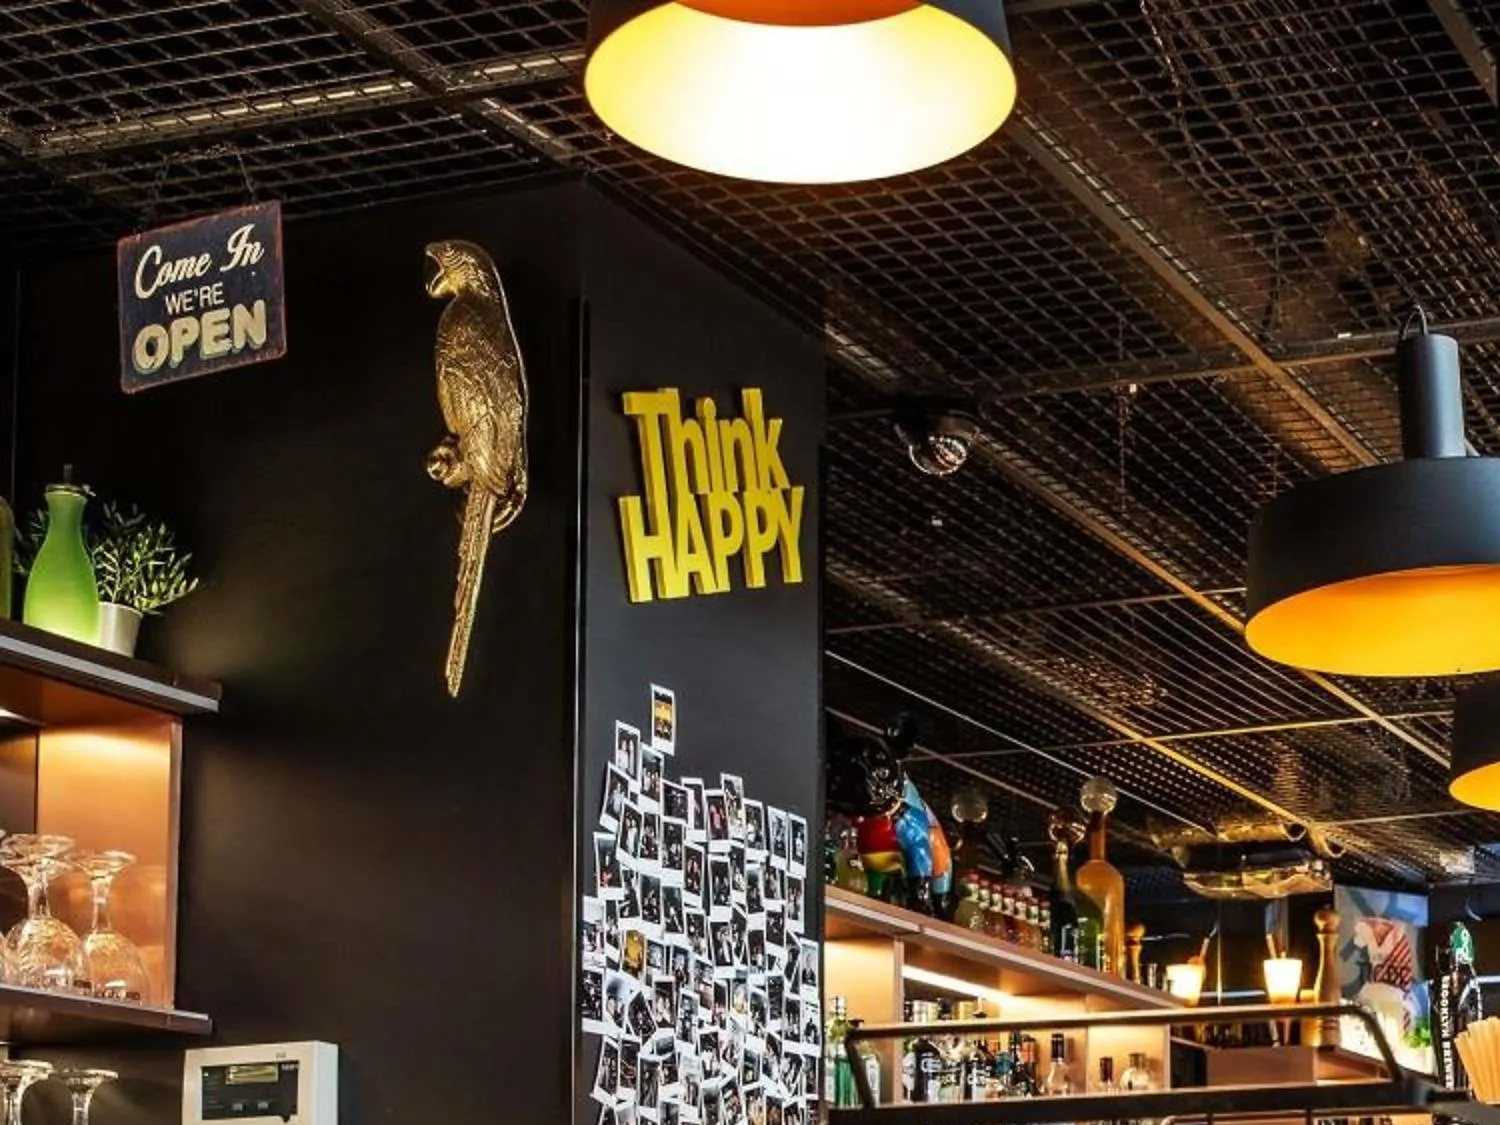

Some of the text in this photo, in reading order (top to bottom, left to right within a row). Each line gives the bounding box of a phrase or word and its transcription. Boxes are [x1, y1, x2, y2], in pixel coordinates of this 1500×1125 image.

[134, 223, 265, 299] Come In
[165, 282, 225, 315] WE'RE
[132, 299, 268, 374] OPEN
[622, 387, 790, 497] Think
[618, 486, 805, 603] HAPPY
